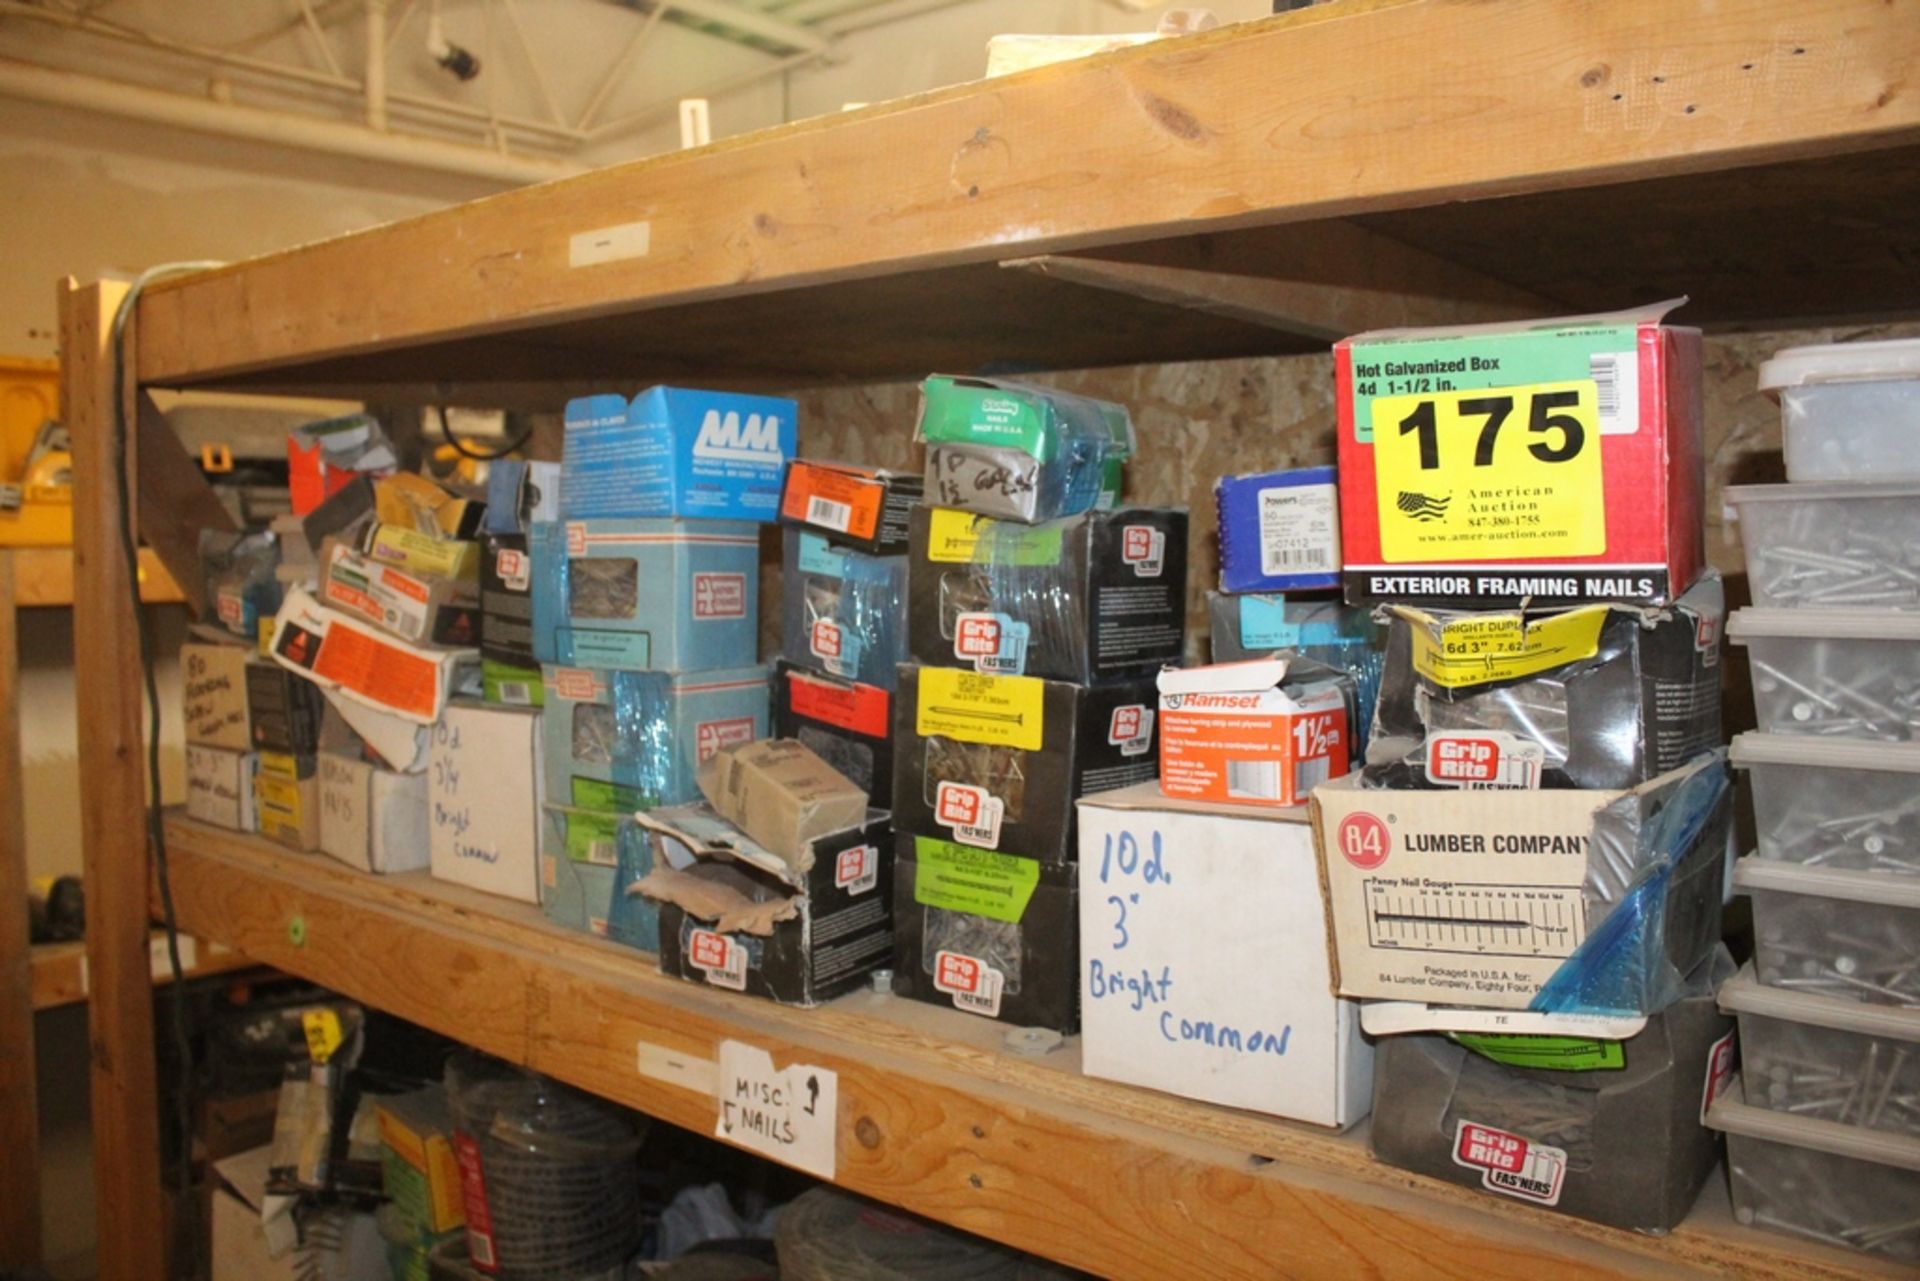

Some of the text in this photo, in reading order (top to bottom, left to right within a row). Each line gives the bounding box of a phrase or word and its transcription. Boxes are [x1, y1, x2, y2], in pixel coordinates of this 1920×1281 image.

[1356, 356, 1500, 378] Hot Galvanized Box
[1357, 377, 1457, 396] 4d 1-1/2 in.
[1398, 390, 1586, 470] 175
[1468, 486, 1553, 499] American
[1468, 501, 1538, 513] Auction
[1370, 576, 1653, 598] EXTERIOR FRAMING NAILS
[1183, 693, 1261, 708] Ramset
[1440, 741, 1490, 762] Grip
[1440, 761, 1487, 778] Rite
[1346, 825, 1383, 856] 84
[1405, 834, 1486, 852] LUMBER
[1372, 876, 1398, 887] Penny
[1394, 975, 1426, 985] Lumber
[1424, 966, 1468, 978] Packaged
[1090, 960, 1172, 1010] Bright
[742, 1106, 795, 1144] NAILS
[1471, 1128, 1519, 1153] Grip
[1469, 1143, 1514, 1168] Rite
